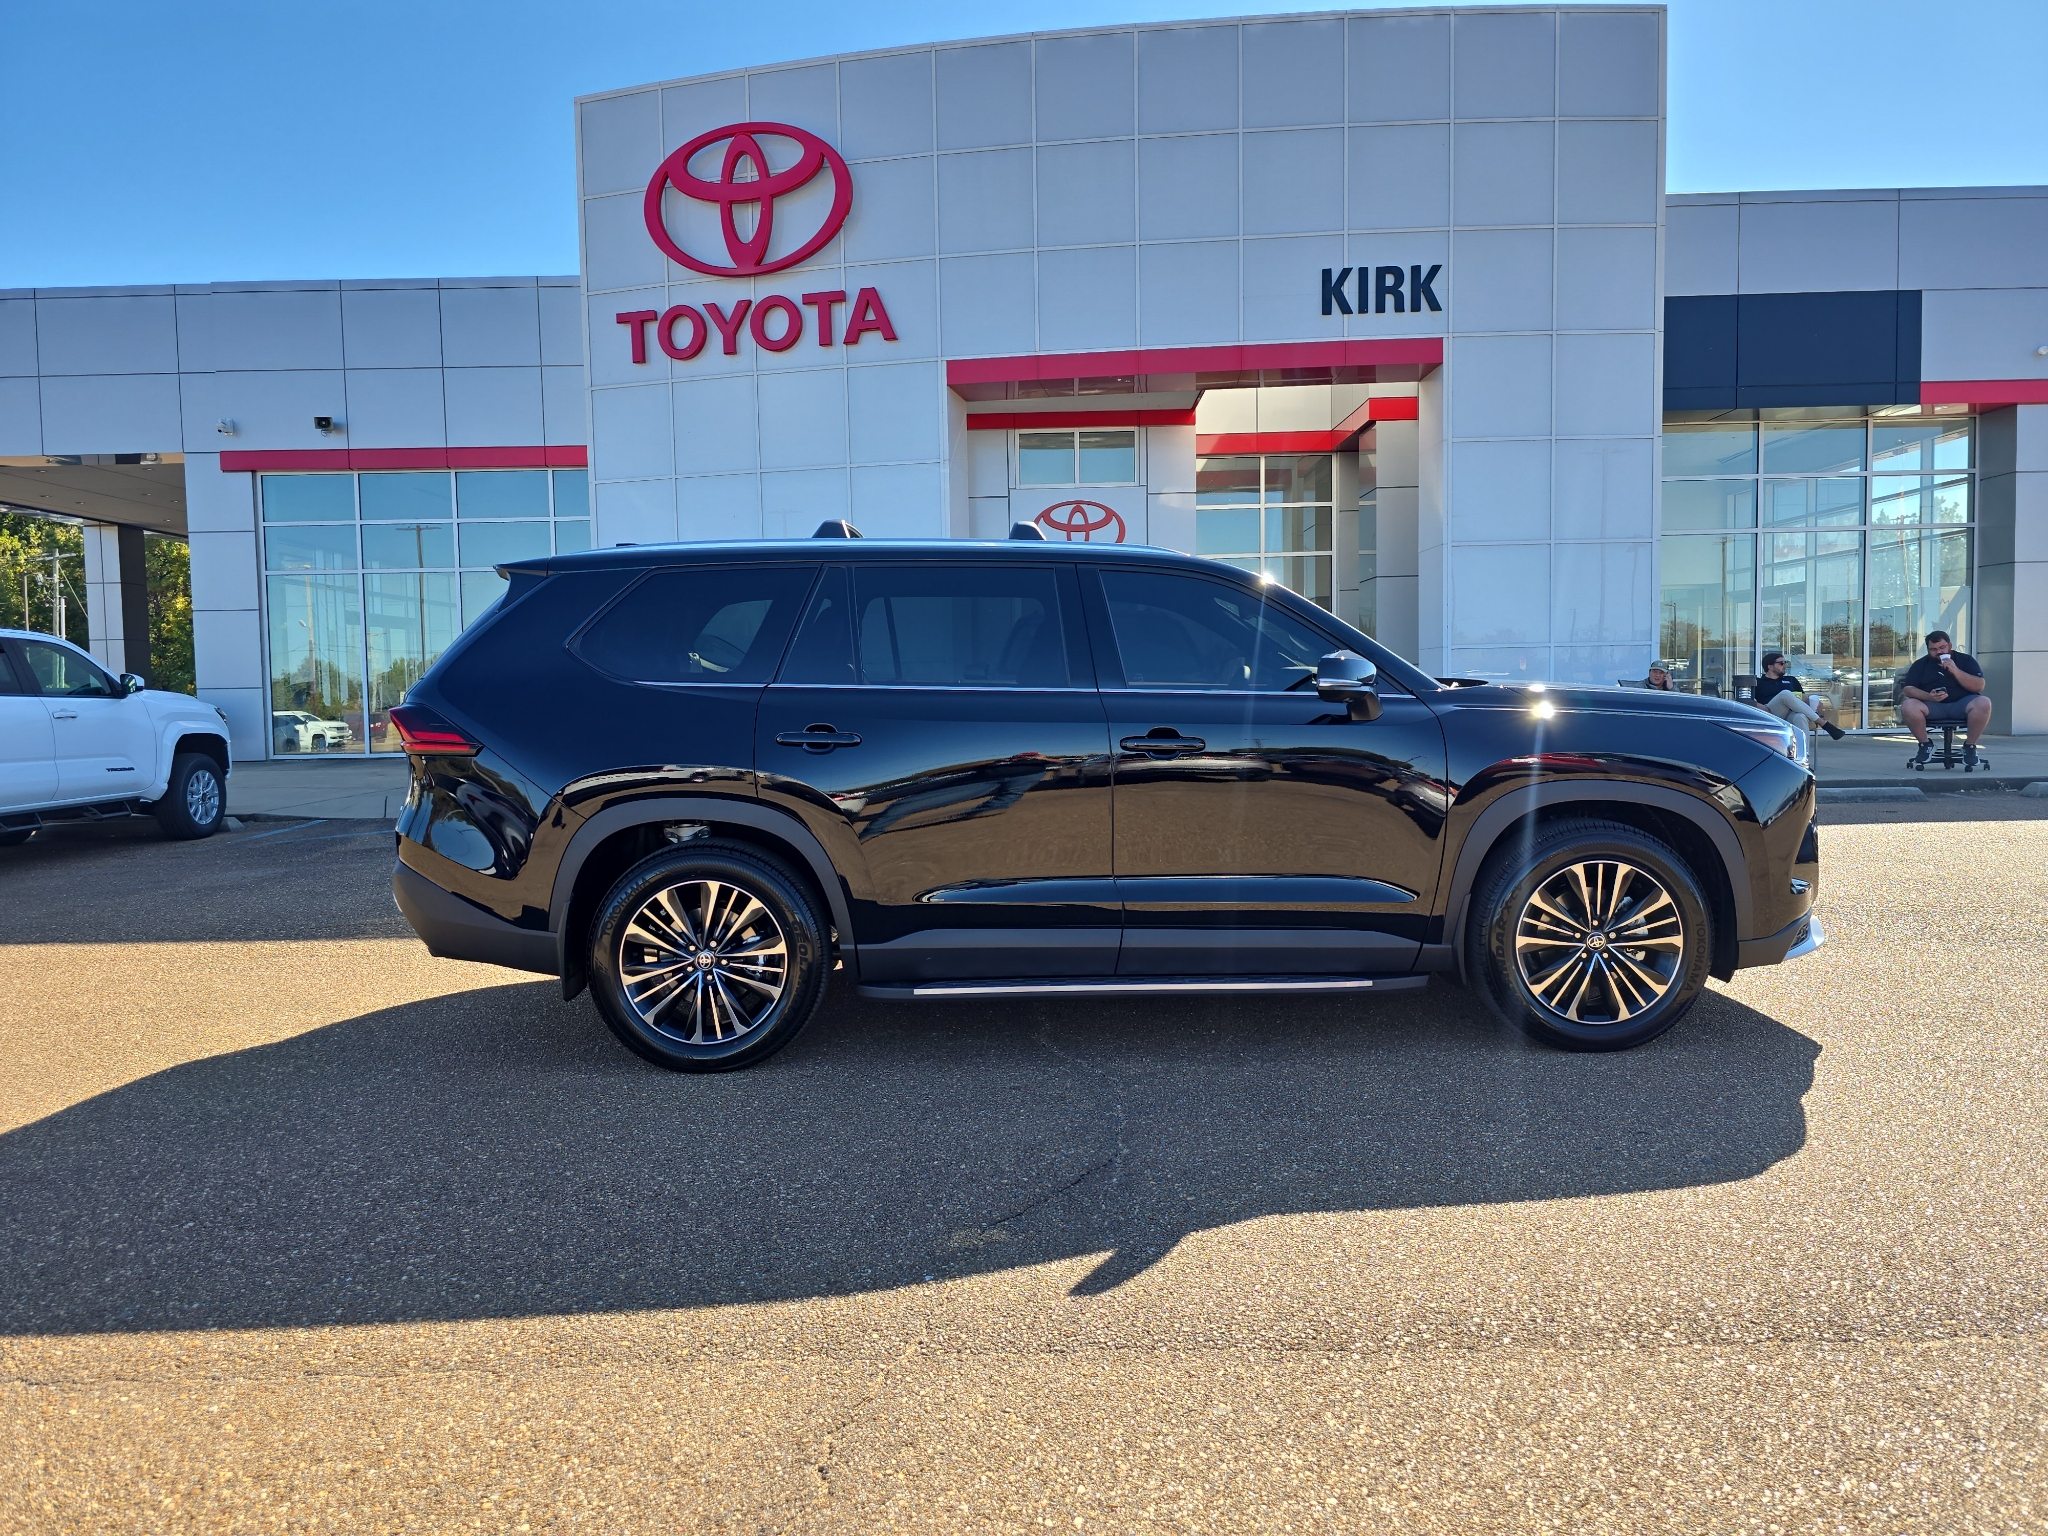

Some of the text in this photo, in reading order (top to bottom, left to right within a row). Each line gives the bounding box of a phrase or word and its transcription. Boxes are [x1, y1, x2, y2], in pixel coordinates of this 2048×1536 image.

[1321, 264, 1443, 315] KIRK
[616, 287, 898, 364] TOYOTA
[598, 877, 650, 939] YOKOHAMA
[1683, 919, 1706, 991] YOKOHAMA
